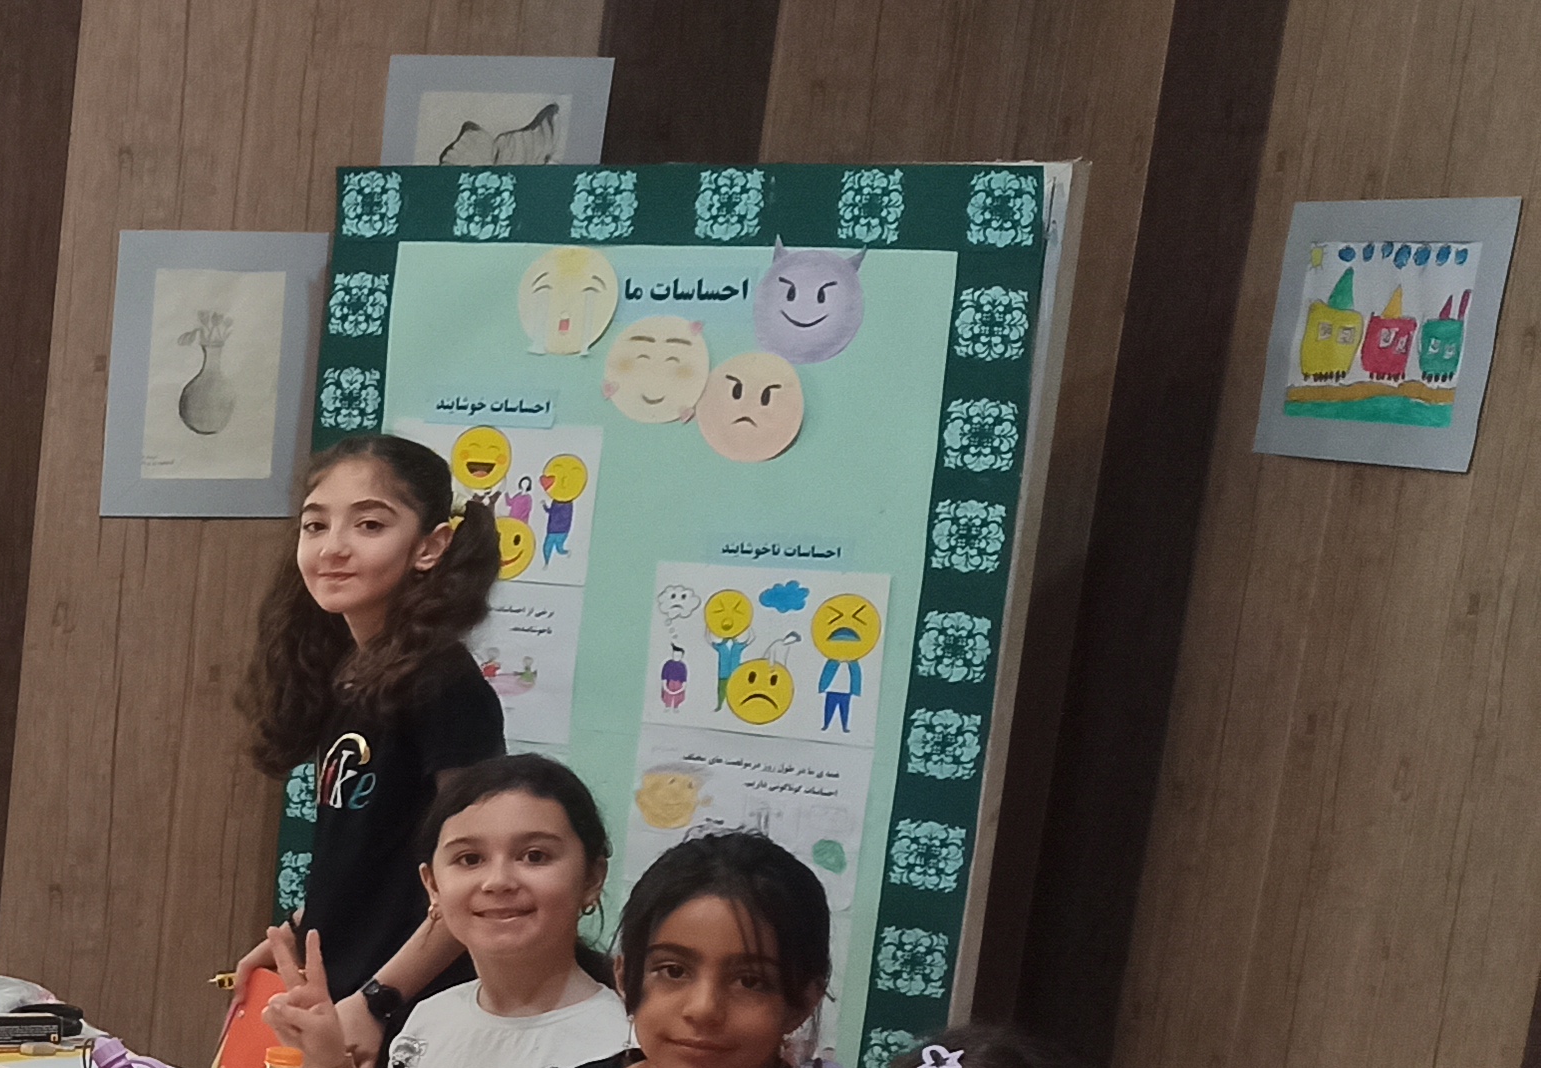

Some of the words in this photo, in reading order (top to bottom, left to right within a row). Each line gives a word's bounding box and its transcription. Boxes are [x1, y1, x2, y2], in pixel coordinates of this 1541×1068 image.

[625, 277, 643, 300] ما
[650, 277, 749, 301] احساسات
[436, 396, 486, 416] خوشایند
[490, 398, 550, 413] احساسات
[722, 541, 780, 559] ناخوشایند
[783, 544, 841, 558] احساسات
